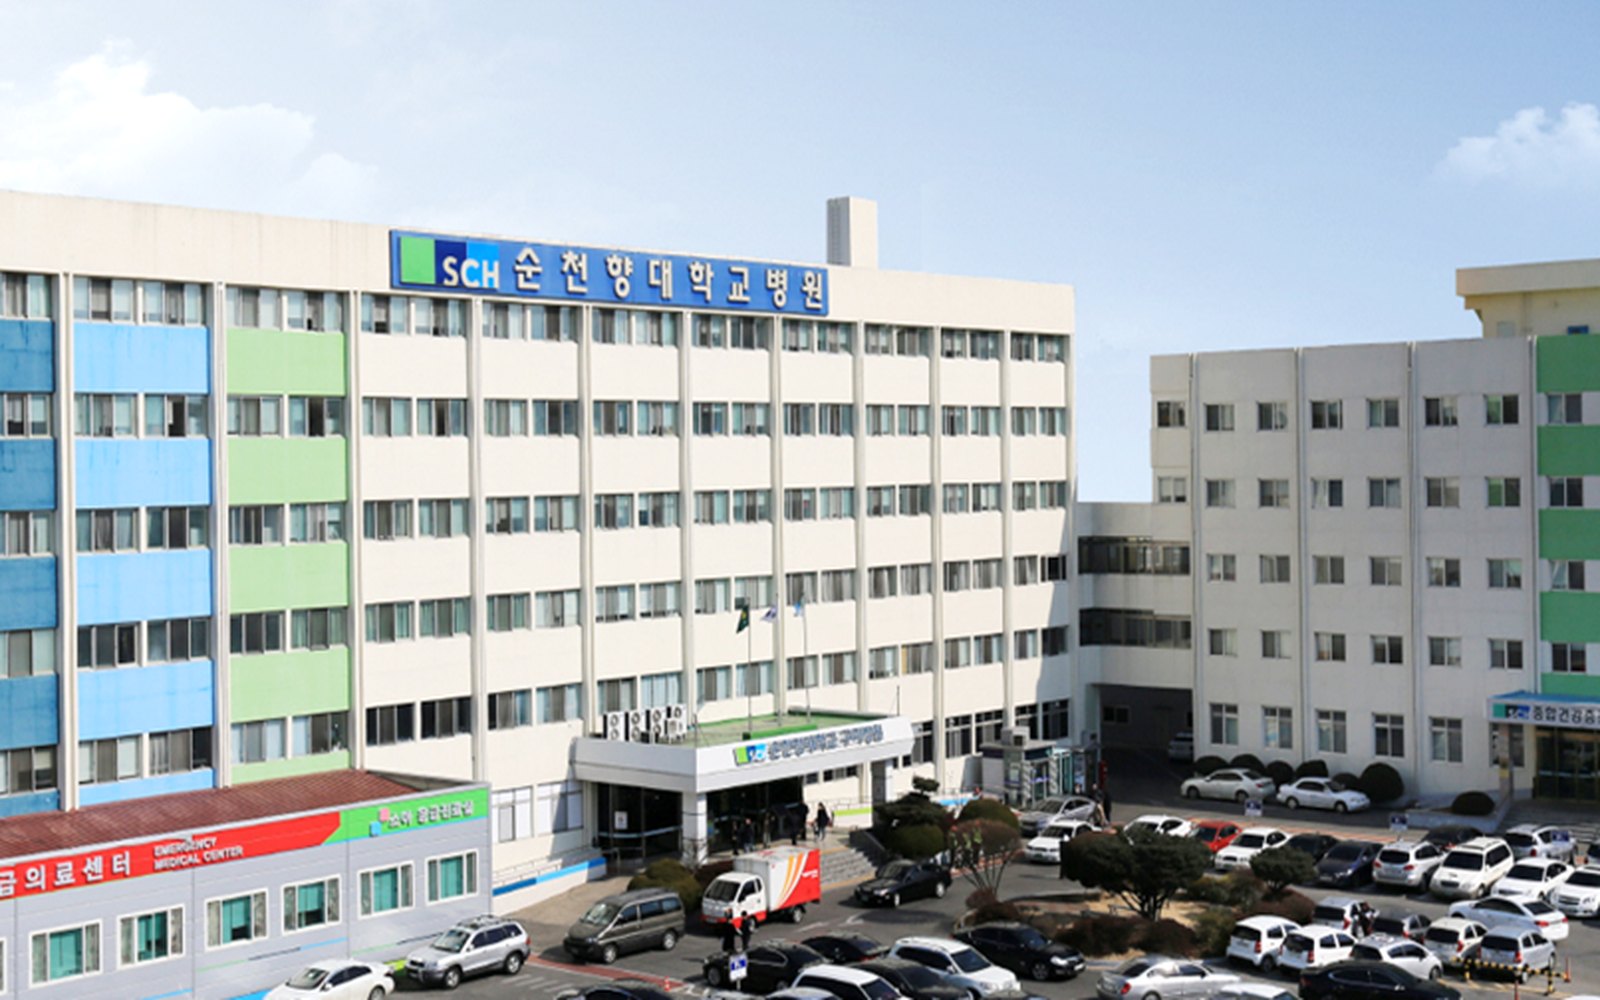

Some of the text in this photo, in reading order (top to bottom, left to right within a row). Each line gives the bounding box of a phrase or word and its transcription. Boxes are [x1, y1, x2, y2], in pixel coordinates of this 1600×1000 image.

[442, 256, 499, 289] SCH
[515, 247, 823, 310] 순천향대학교병원
[1533, 705, 1600, 725] 종합건강증
[154, 836, 217, 857] EMERGENCY
[154, 845, 244, 870] MEDICAL CENTER
